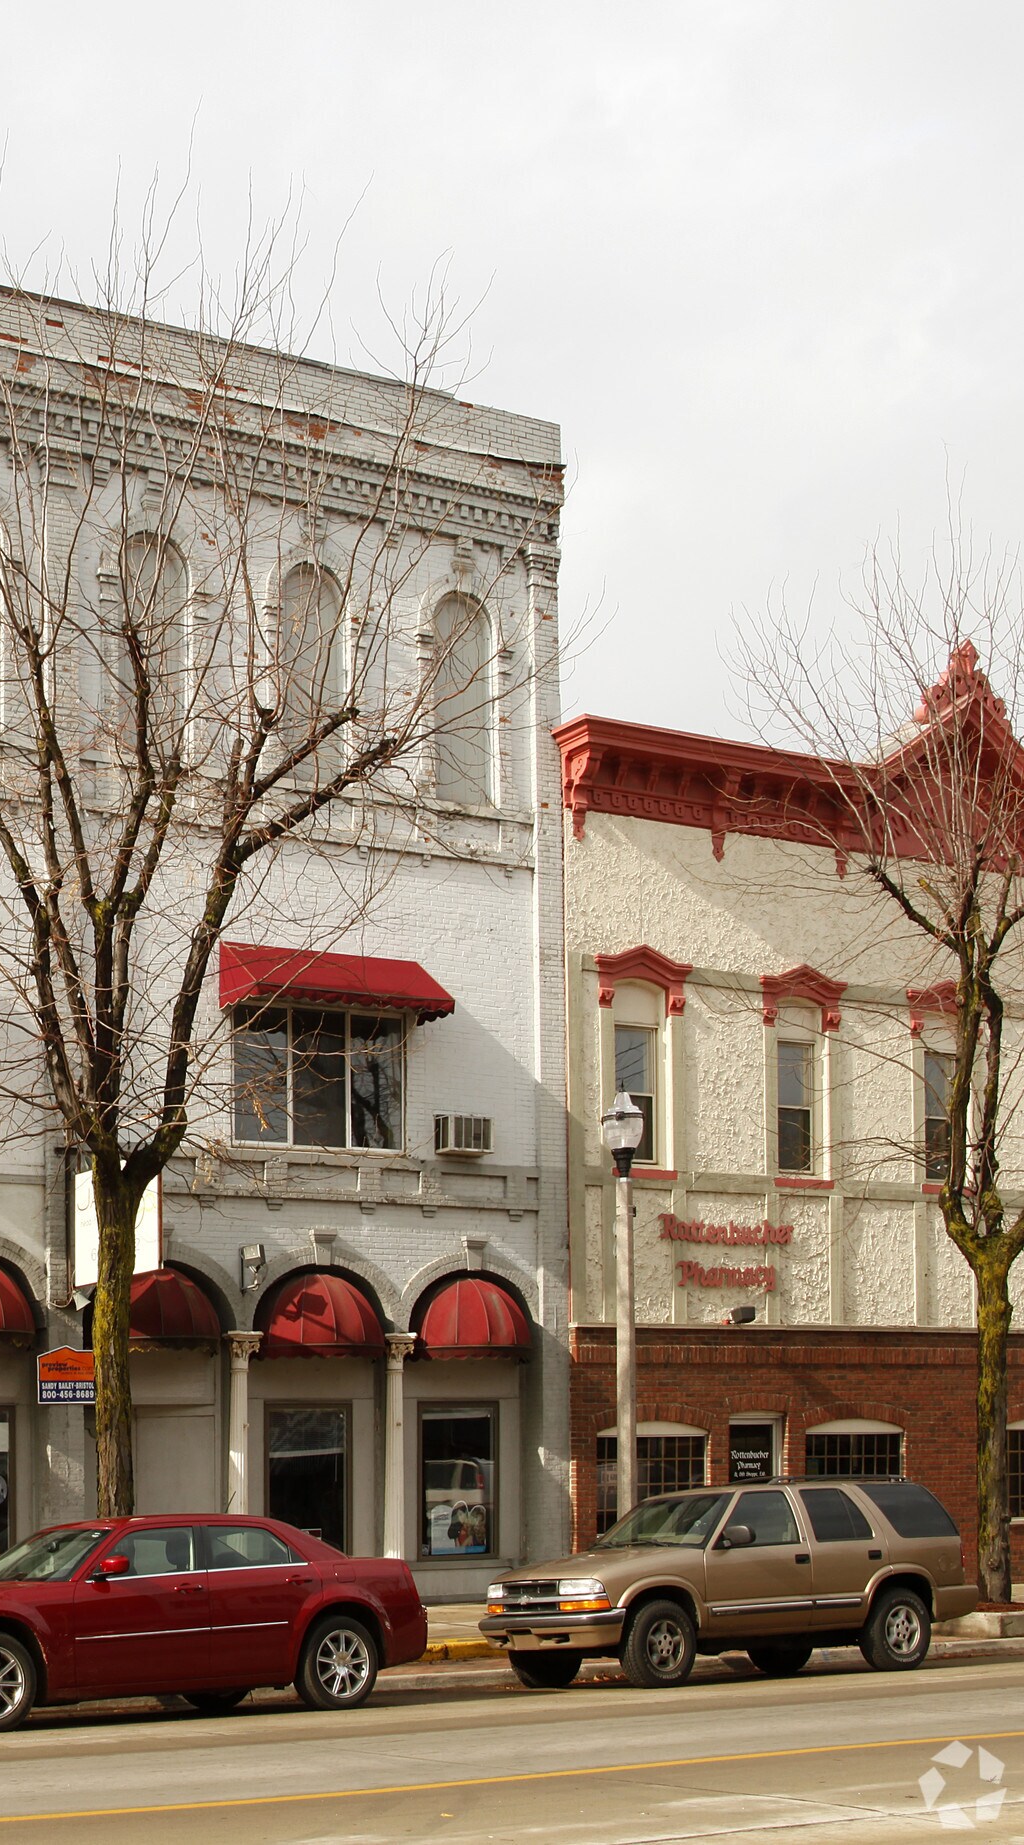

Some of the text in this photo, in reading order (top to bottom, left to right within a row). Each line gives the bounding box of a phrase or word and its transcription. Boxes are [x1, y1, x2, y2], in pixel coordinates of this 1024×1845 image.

[658, 1213, 794, 1245] Rattenbucher
[677, 1260, 776, 1293] Pharmacy
[42, 1390, 94, 1399] 800-456-8689
[736, 1461, 761, 1470] Pharmacy
